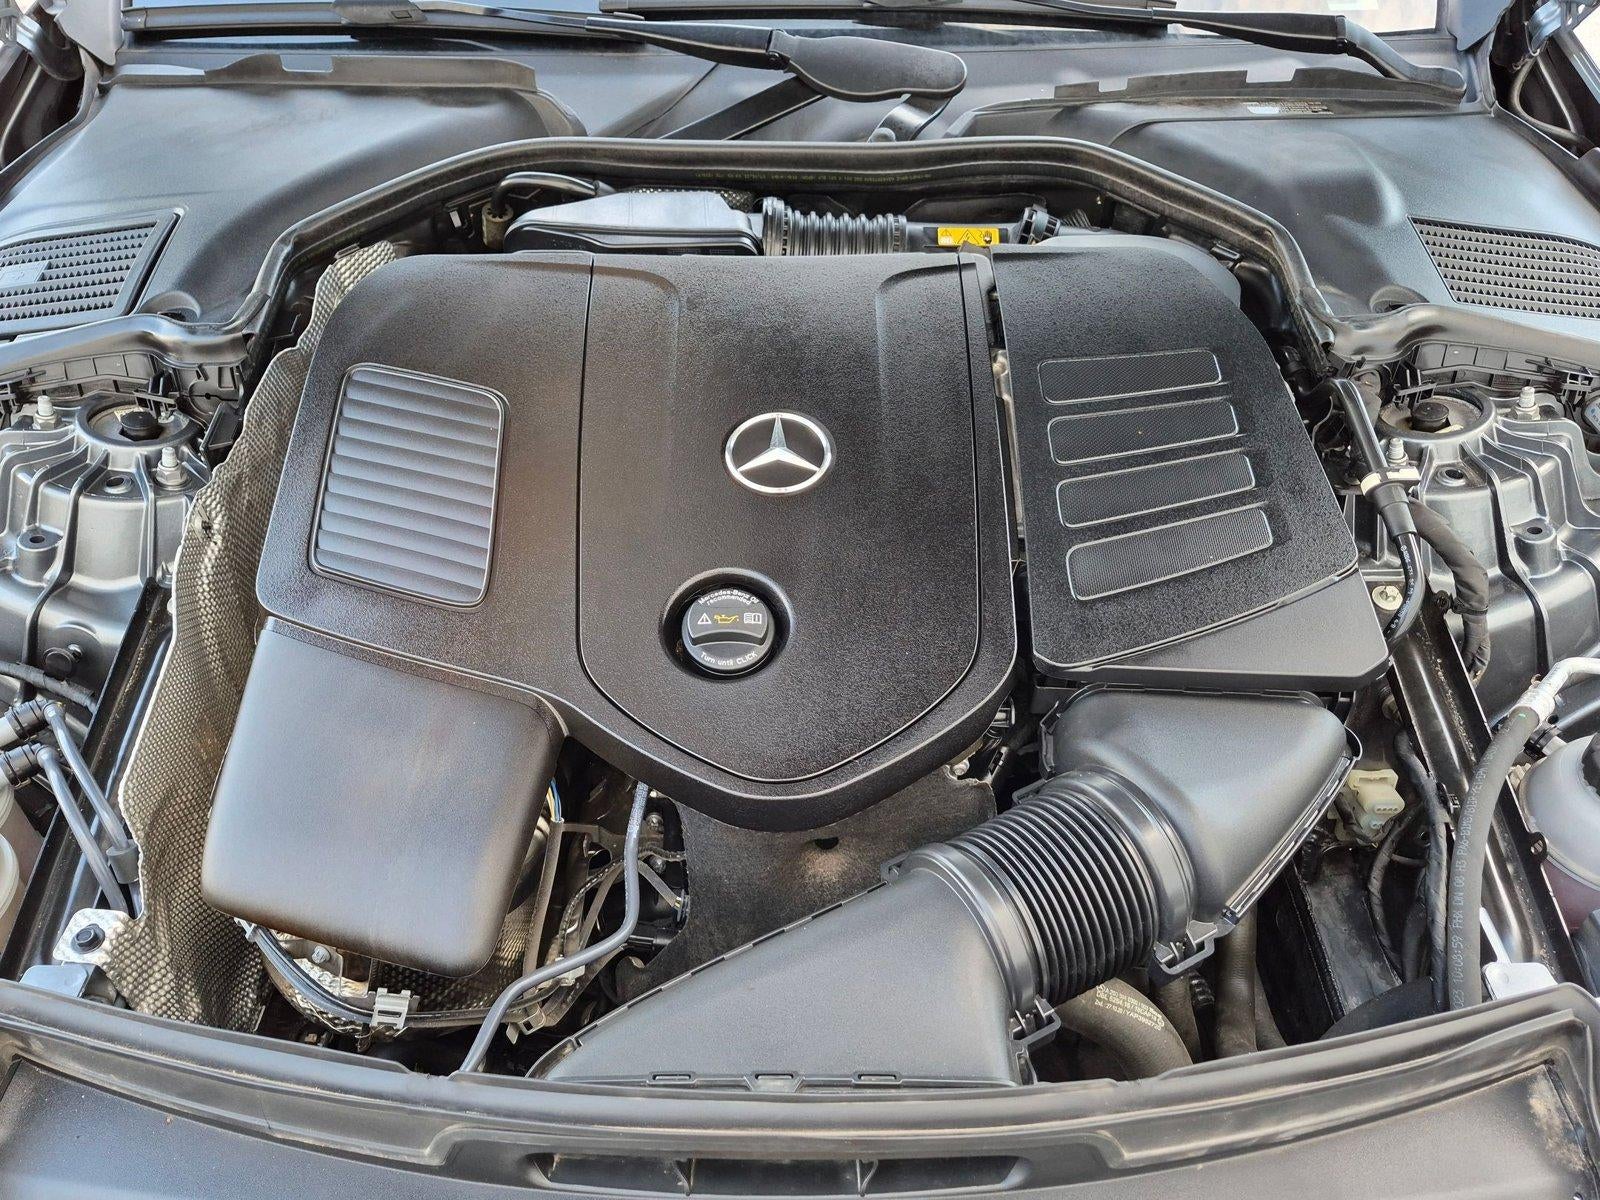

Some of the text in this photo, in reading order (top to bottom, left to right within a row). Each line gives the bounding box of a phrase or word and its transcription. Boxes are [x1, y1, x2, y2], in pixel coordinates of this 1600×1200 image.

[700, 651, 758, 666] Turn until CLICK
